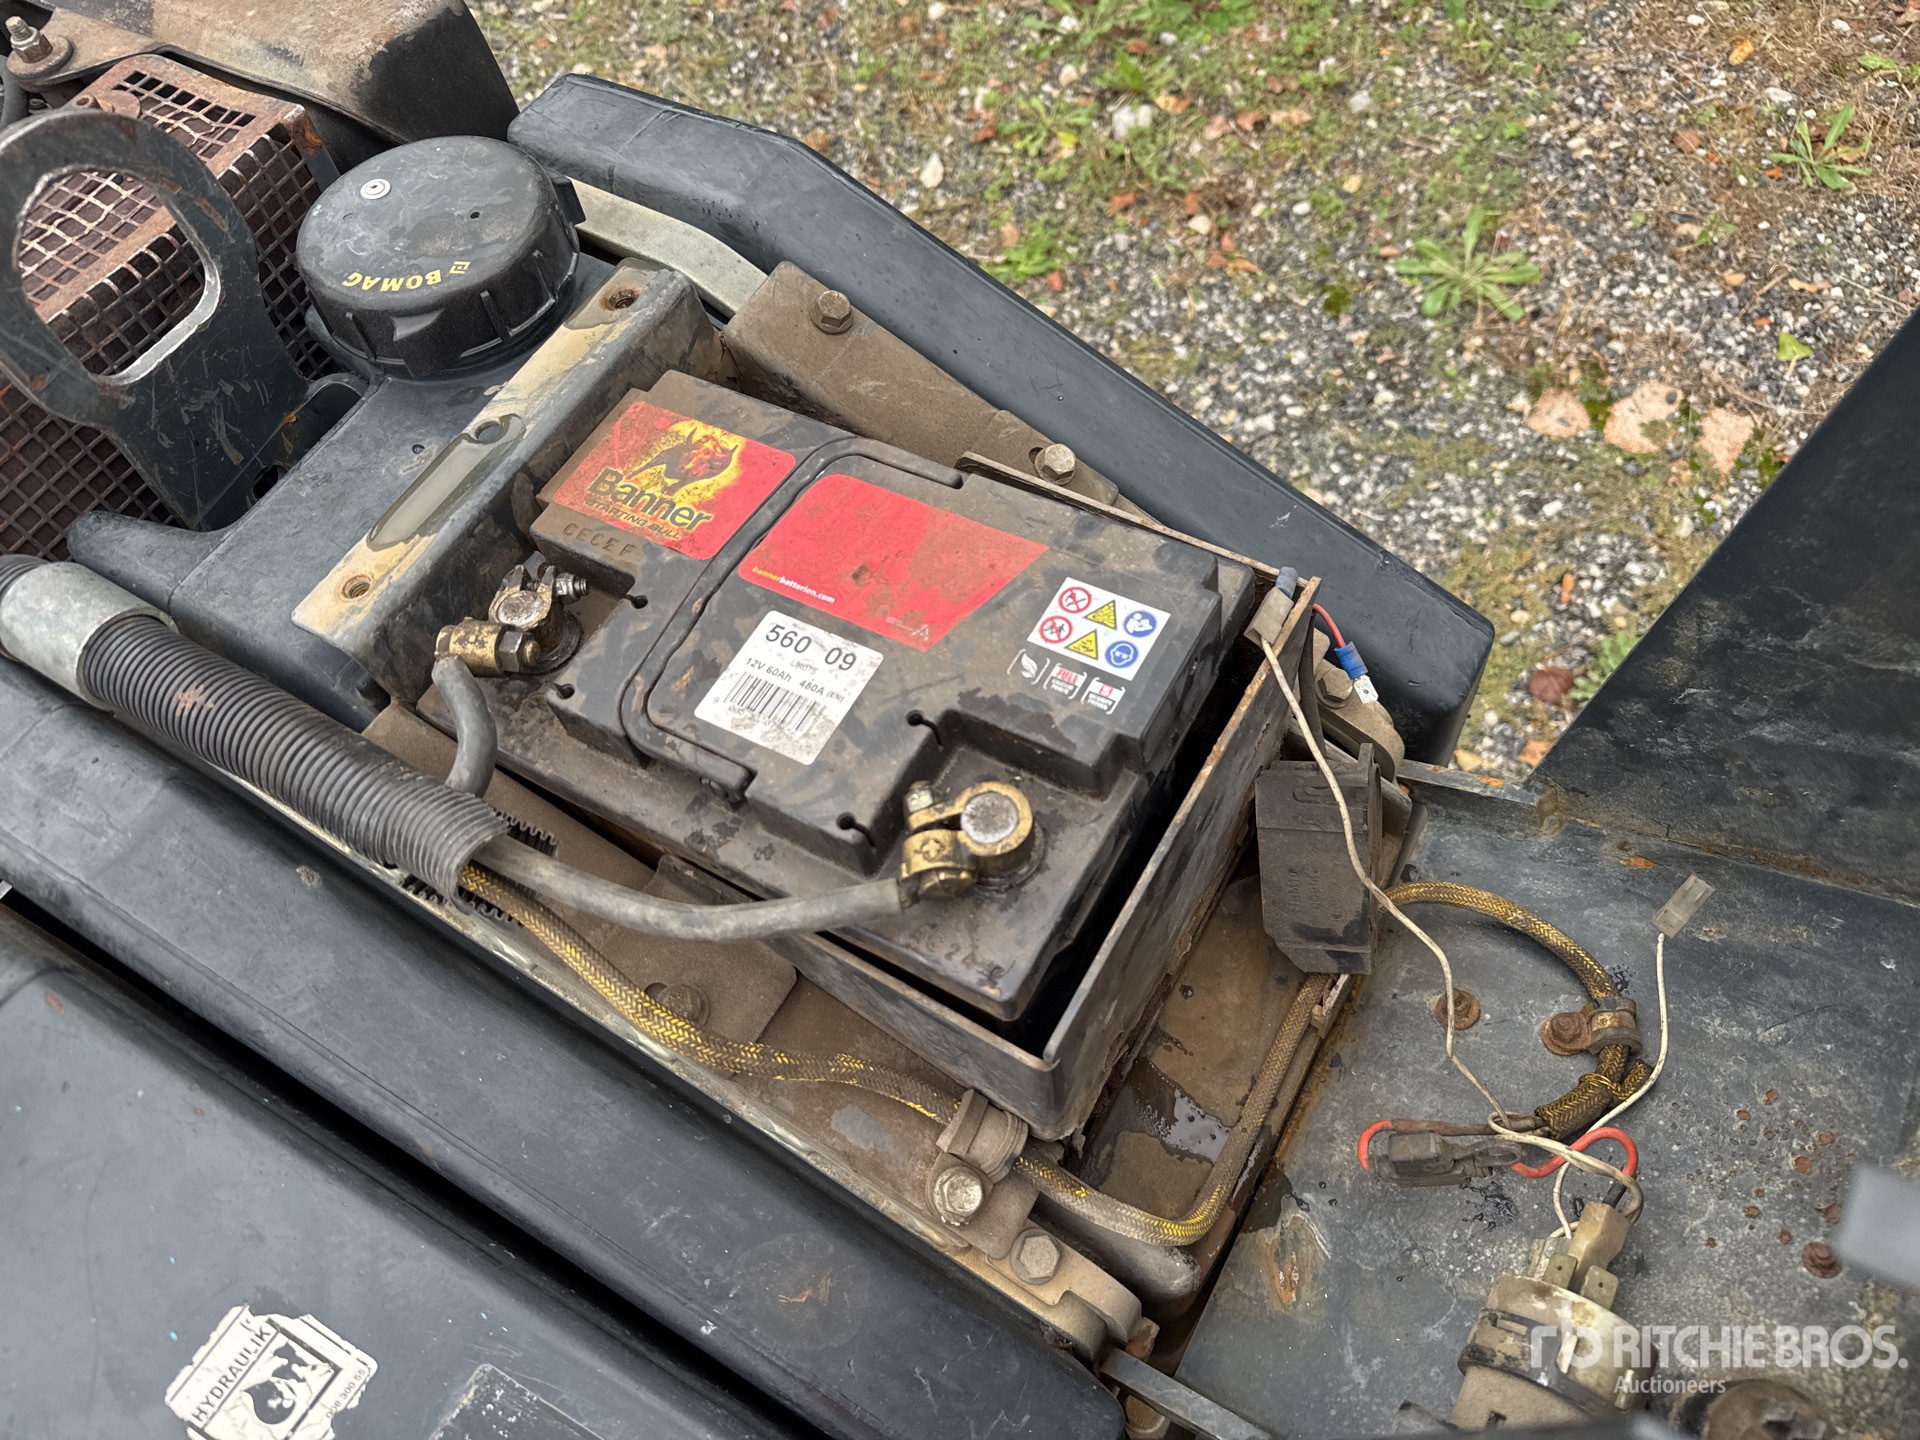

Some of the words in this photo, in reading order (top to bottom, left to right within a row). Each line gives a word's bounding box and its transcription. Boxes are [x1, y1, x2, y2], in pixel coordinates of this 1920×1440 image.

[343, 270, 441, 291] BOMAG
[586, 496, 646, 527] STARTING
[649, 523, 681, 540] BULL
[588, 467, 712, 531] Banner
[752, 565, 836, 604] bannerbatterien.com
[765, 624, 812, 653] 560
[824, 647, 857, 671] 09
[746, 657, 766, 670] 12V
[766, 665, 792, 682] 60Ah
[799, 679, 825, 696] 480A
[1056, 667, 1079, 685] FULL
[192, 1326, 271, 1423] HYDRAULIK
[340, 1381, 356, 1400] 300
[355, 1367, 366, 1382] 55
